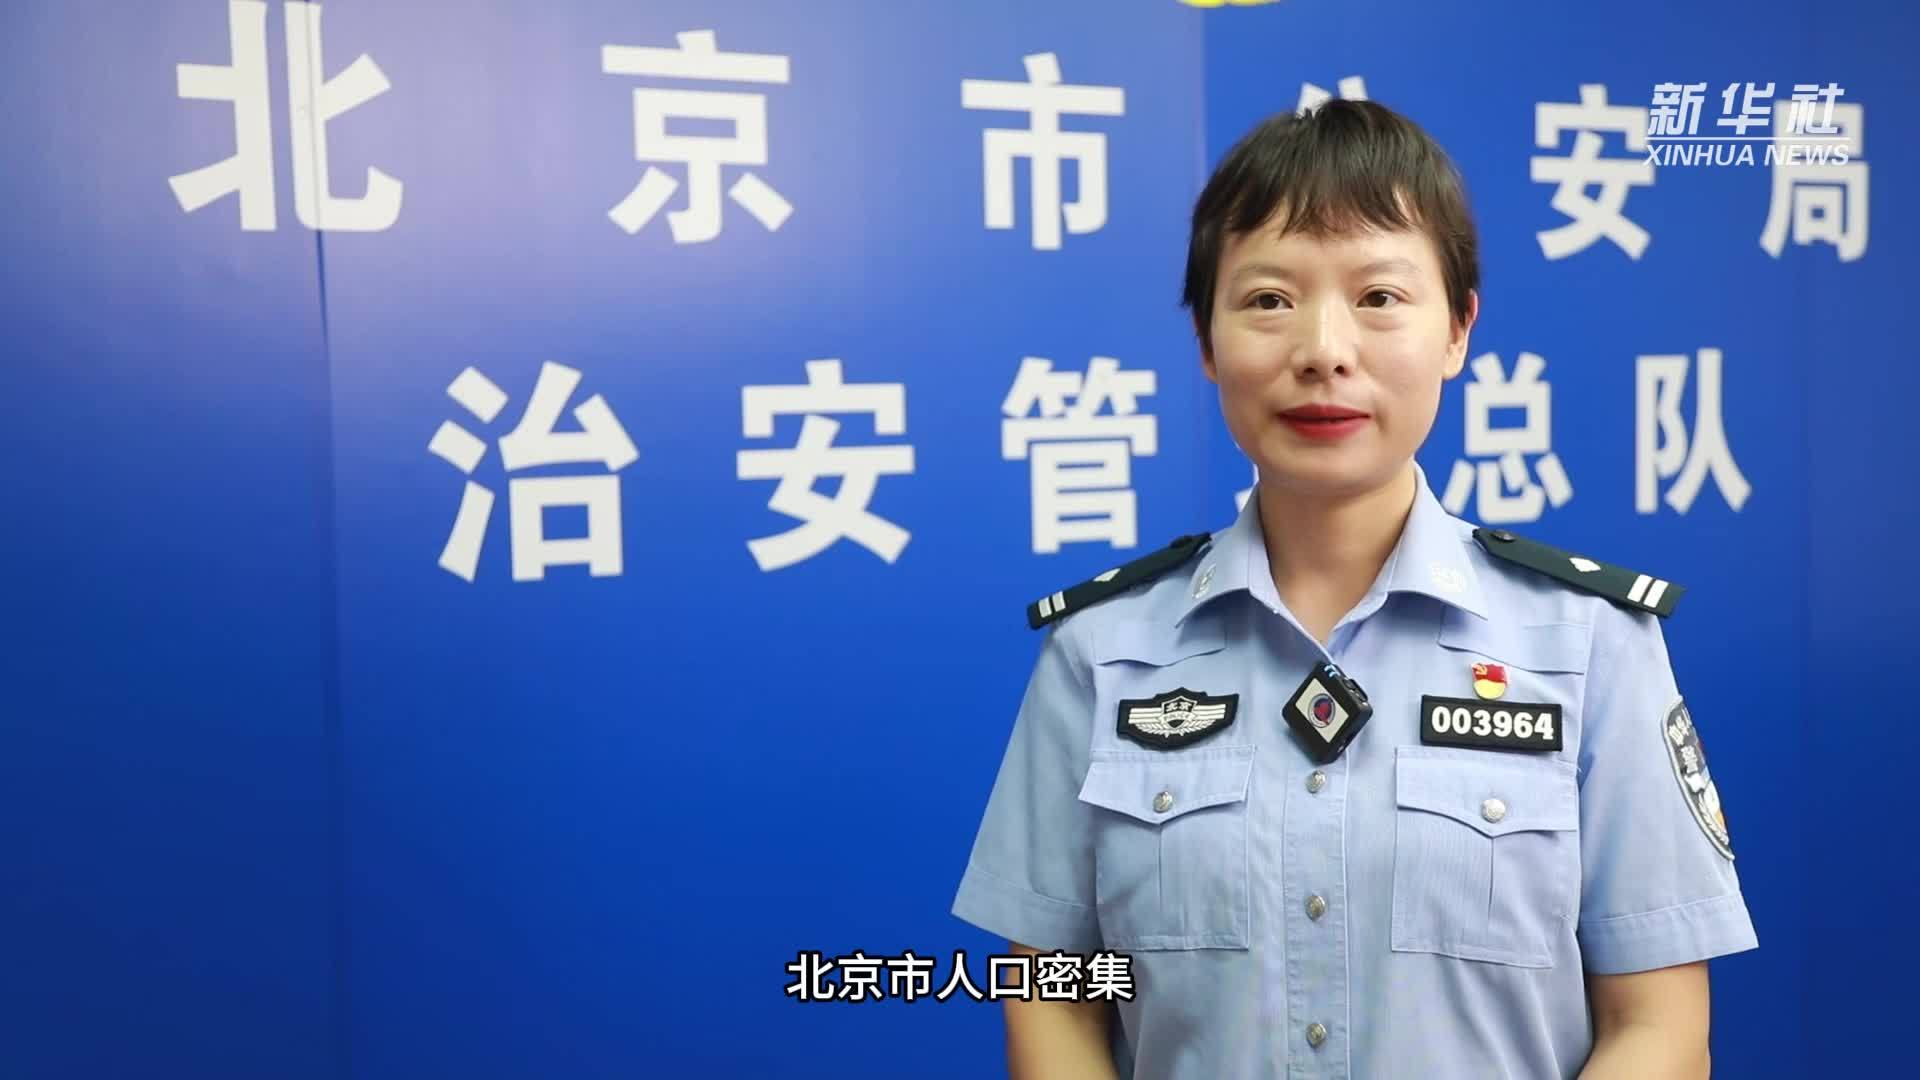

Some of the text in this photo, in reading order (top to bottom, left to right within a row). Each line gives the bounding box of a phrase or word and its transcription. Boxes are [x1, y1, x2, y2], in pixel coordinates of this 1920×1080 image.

[168, 0, 1870, 262] 北京市安局
[427, 348, 1752, 583] 治安管总队
[1431, 705, 1554, 740] 003964
